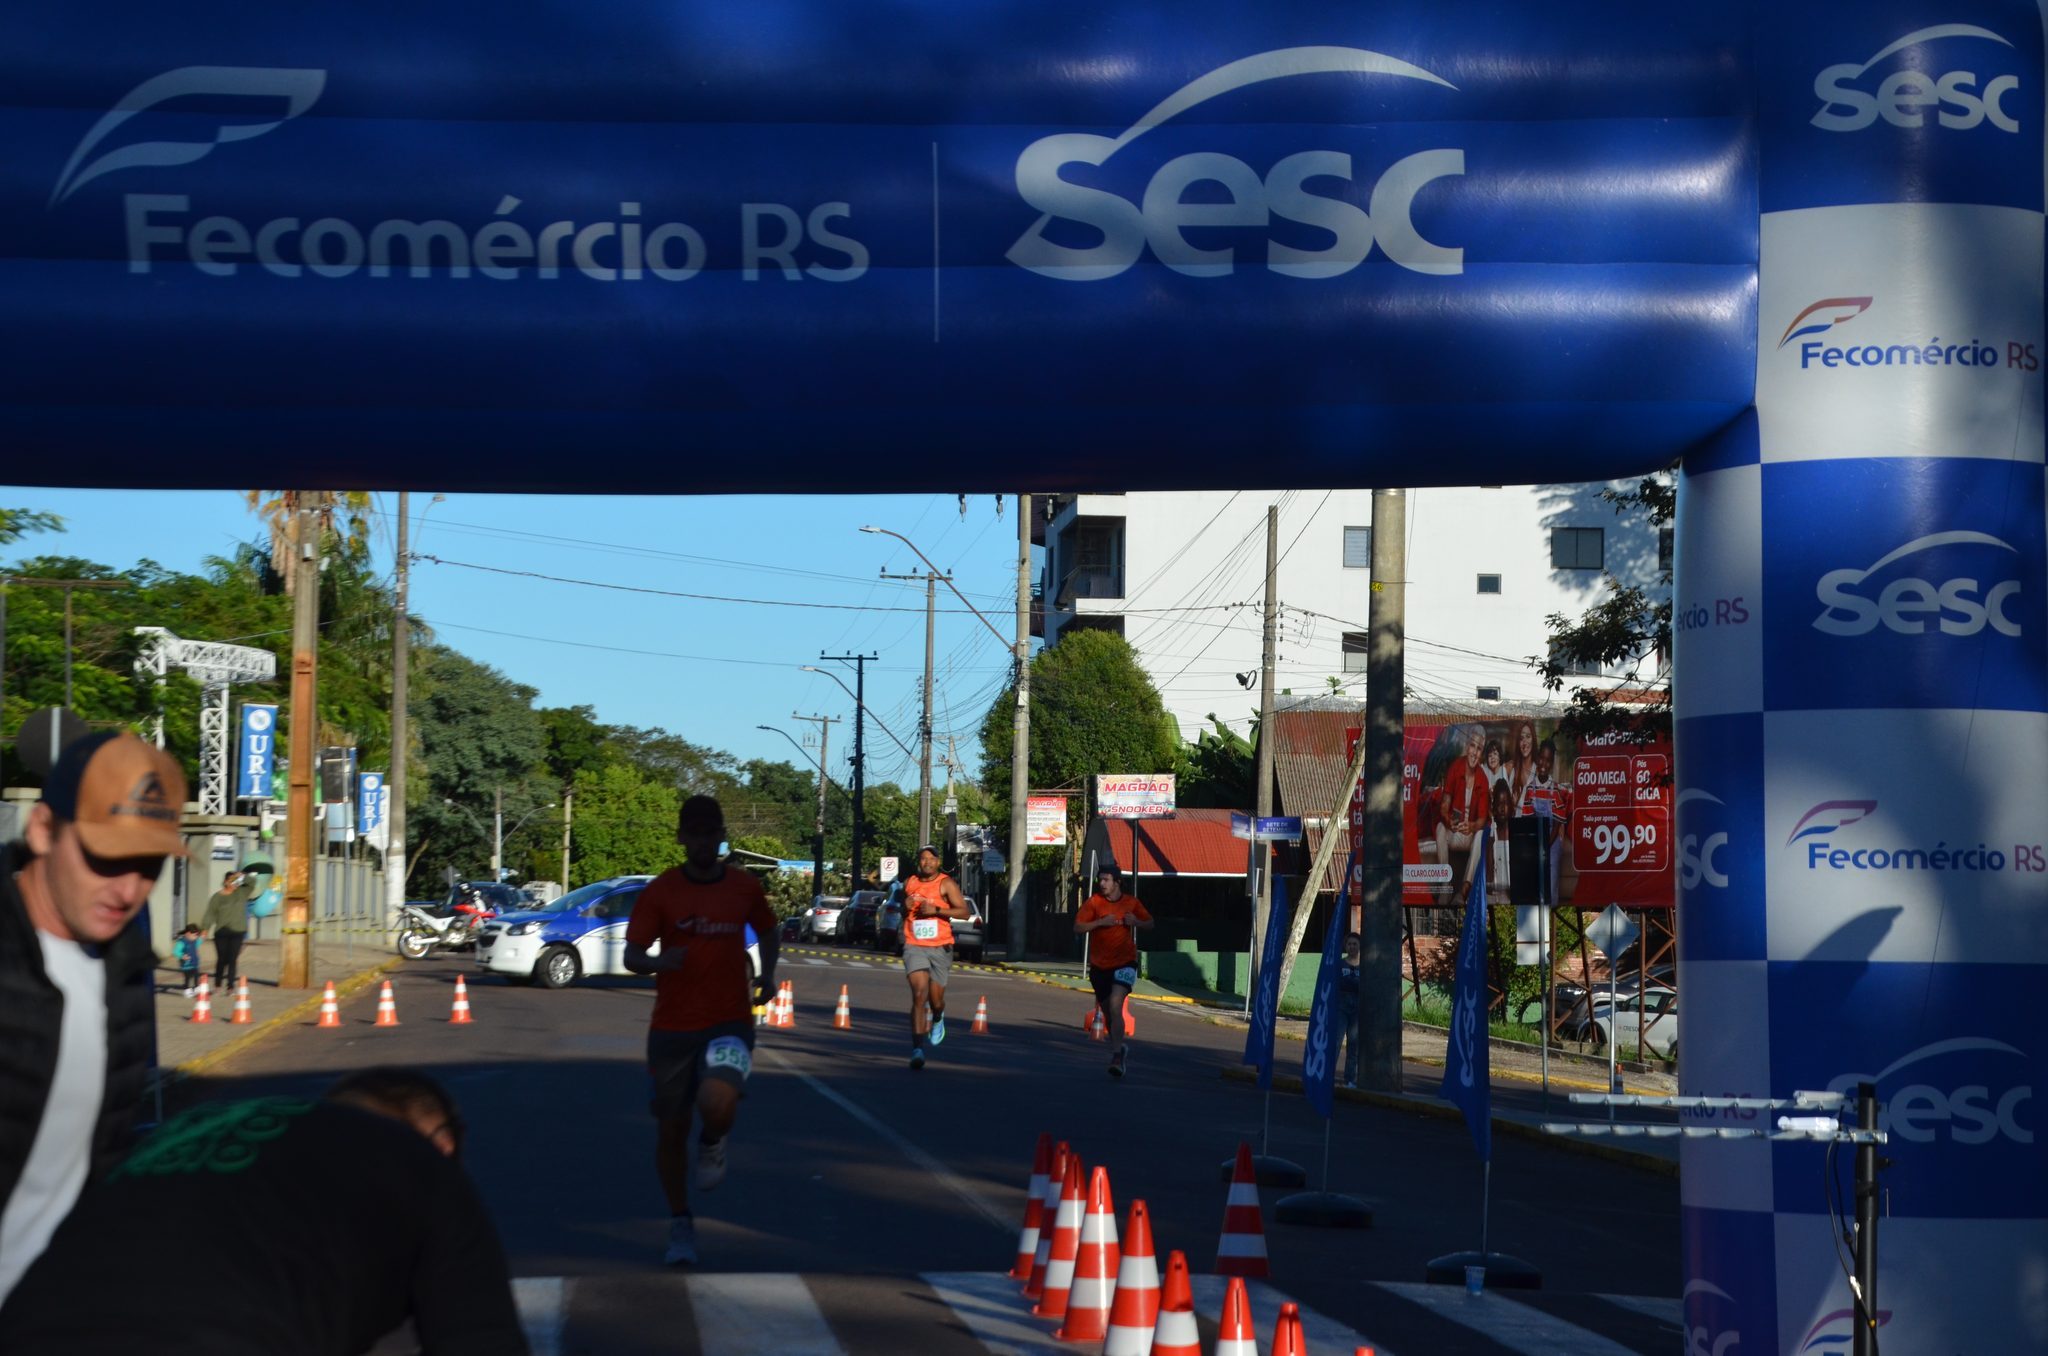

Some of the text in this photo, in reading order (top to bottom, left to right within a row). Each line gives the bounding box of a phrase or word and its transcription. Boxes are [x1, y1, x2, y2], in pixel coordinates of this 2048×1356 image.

[1810, 63, 2019, 134] Sesc
[1004, 133, 1466, 282] Sesc
[124, 194, 871, 283] Fecomércio RS
[1801, 337, 2039, 372] Fecomércio RS
[1715, 597, 1749, 625] RS
[1811, 568, 2022, 638] Sesc
[247, 734, 269, 795] URI
[1577, 771, 1627, 785] 600 MEGA
[1104, 779, 1169, 793] MAGRÃO
[1111, 805, 1163, 814] SNOOKER
[1594, 824, 1657, 864] 99,90
[1808, 841, 2046, 873] Fecomércio RS
[915, 926, 934, 937] 495
